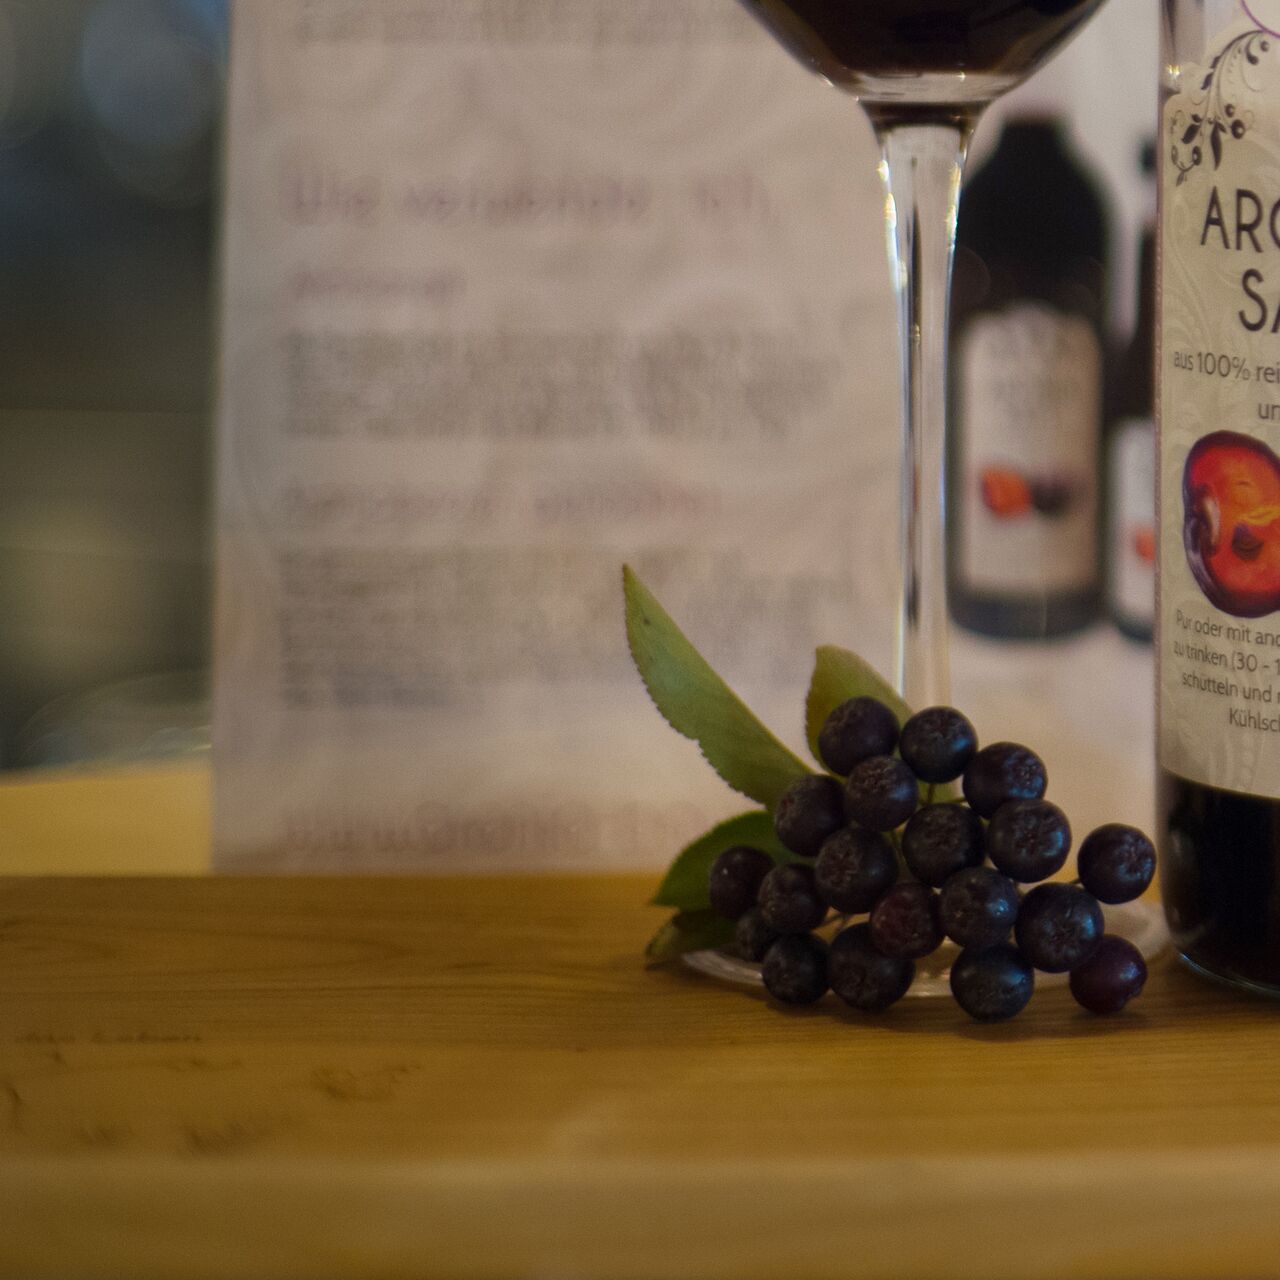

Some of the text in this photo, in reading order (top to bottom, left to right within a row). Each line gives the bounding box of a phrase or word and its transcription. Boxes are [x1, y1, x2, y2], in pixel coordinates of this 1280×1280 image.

[1173, 350, 1194, 371] aus
[1197, 351, 1250, 381] 100%
[1176, 609, 1192, 630] Pur
[1194, 616, 1223, 638] oder
[1226, 623, 1252, 644] mit
[1173, 640, 1185, 657] zu
[1186, 643, 1228, 667] trinken
[1231, 650, 1258, 672] (30
[1243, 685, 1273, 703] und
